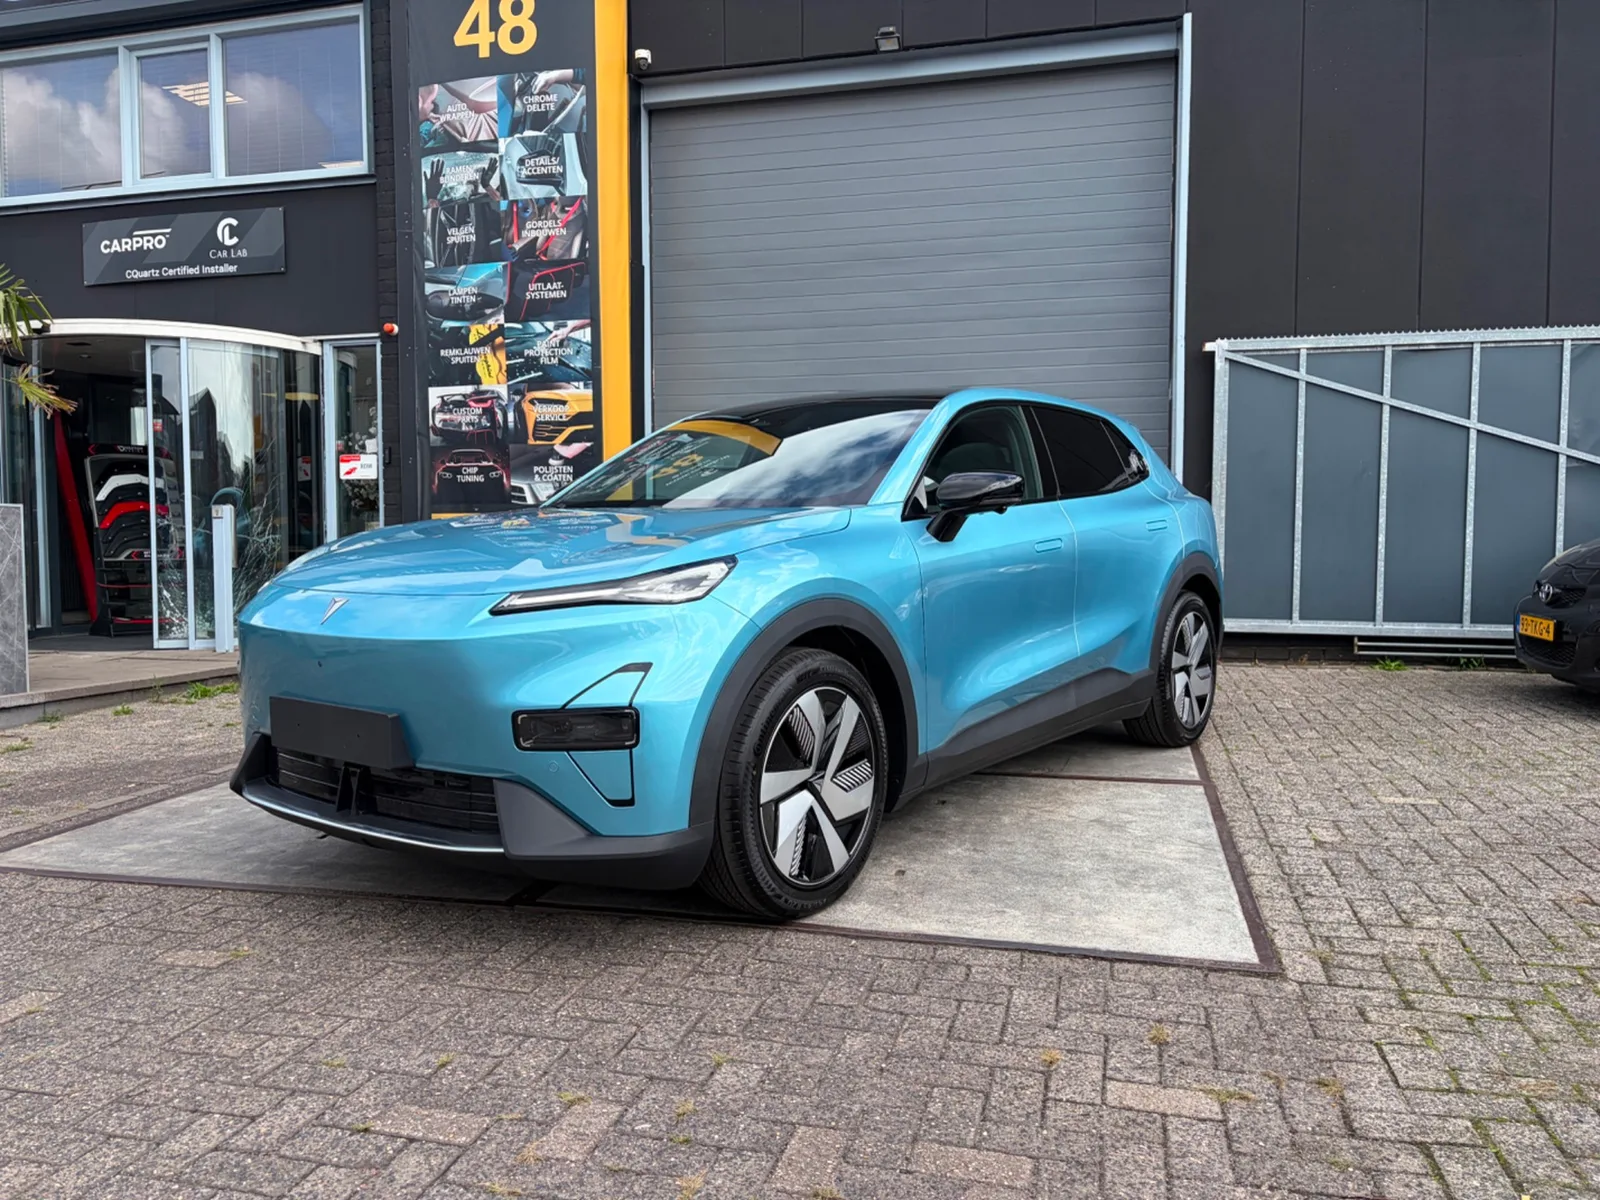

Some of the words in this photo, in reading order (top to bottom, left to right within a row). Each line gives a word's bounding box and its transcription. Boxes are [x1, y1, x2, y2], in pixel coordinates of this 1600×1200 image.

[453, 0, 538, 58] 48
[523, 93, 558, 104] CHROME
[447, 103, 467, 113] AUTO
[526, 103, 556, 112] DELETE
[440, 110, 475, 121] WRAPPEN
[525, 157, 560, 167] DETAILS/
[522, 165, 563, 175] ACCENTEN
[526, 220, 562, 229] GORDELS
[447, 226, 475, 236] VELGEN
[522, 228, 567, 237] INBOUWEN
[100, 235, 167, 254] CARPRO
[446, 234, 476, 245] SPUITEN
[125, 269, 160, 279] CQuartz
[163, 265, 199, 276] Certified
[201, 263, 238, 274] Installer
[448, 286, 478, 297] LAMPEN
[528, 283, 564, 292] UITLAAT-
[450, 295, 476, 304] TINTEN
[526, 290, 567, 300] SYSTEMEN
[537, 340, 560, 349] PAINT
[440, 346, 491, 357] REMKLAUWEN
[524, 348, 573, 357] PROTECTION
[451, 355, 481, 365] SPUITEN
[540, 356, 559, 365] FILM
[452, 407, 482, 416] CUSTOM
[533, 404, 570, 413] VERKOOP
[456, 415, 479, 424] PARTS
[536, 413, 568, 422] SERVICE
[461, 466, 479, 476] CHIP
[533, 465, 573, 474] POLIJSTEN
[456, 474, 485, 483] TUNING
[533, 474, 541, 483] &
[542, 473, 573, 483] COATEN
